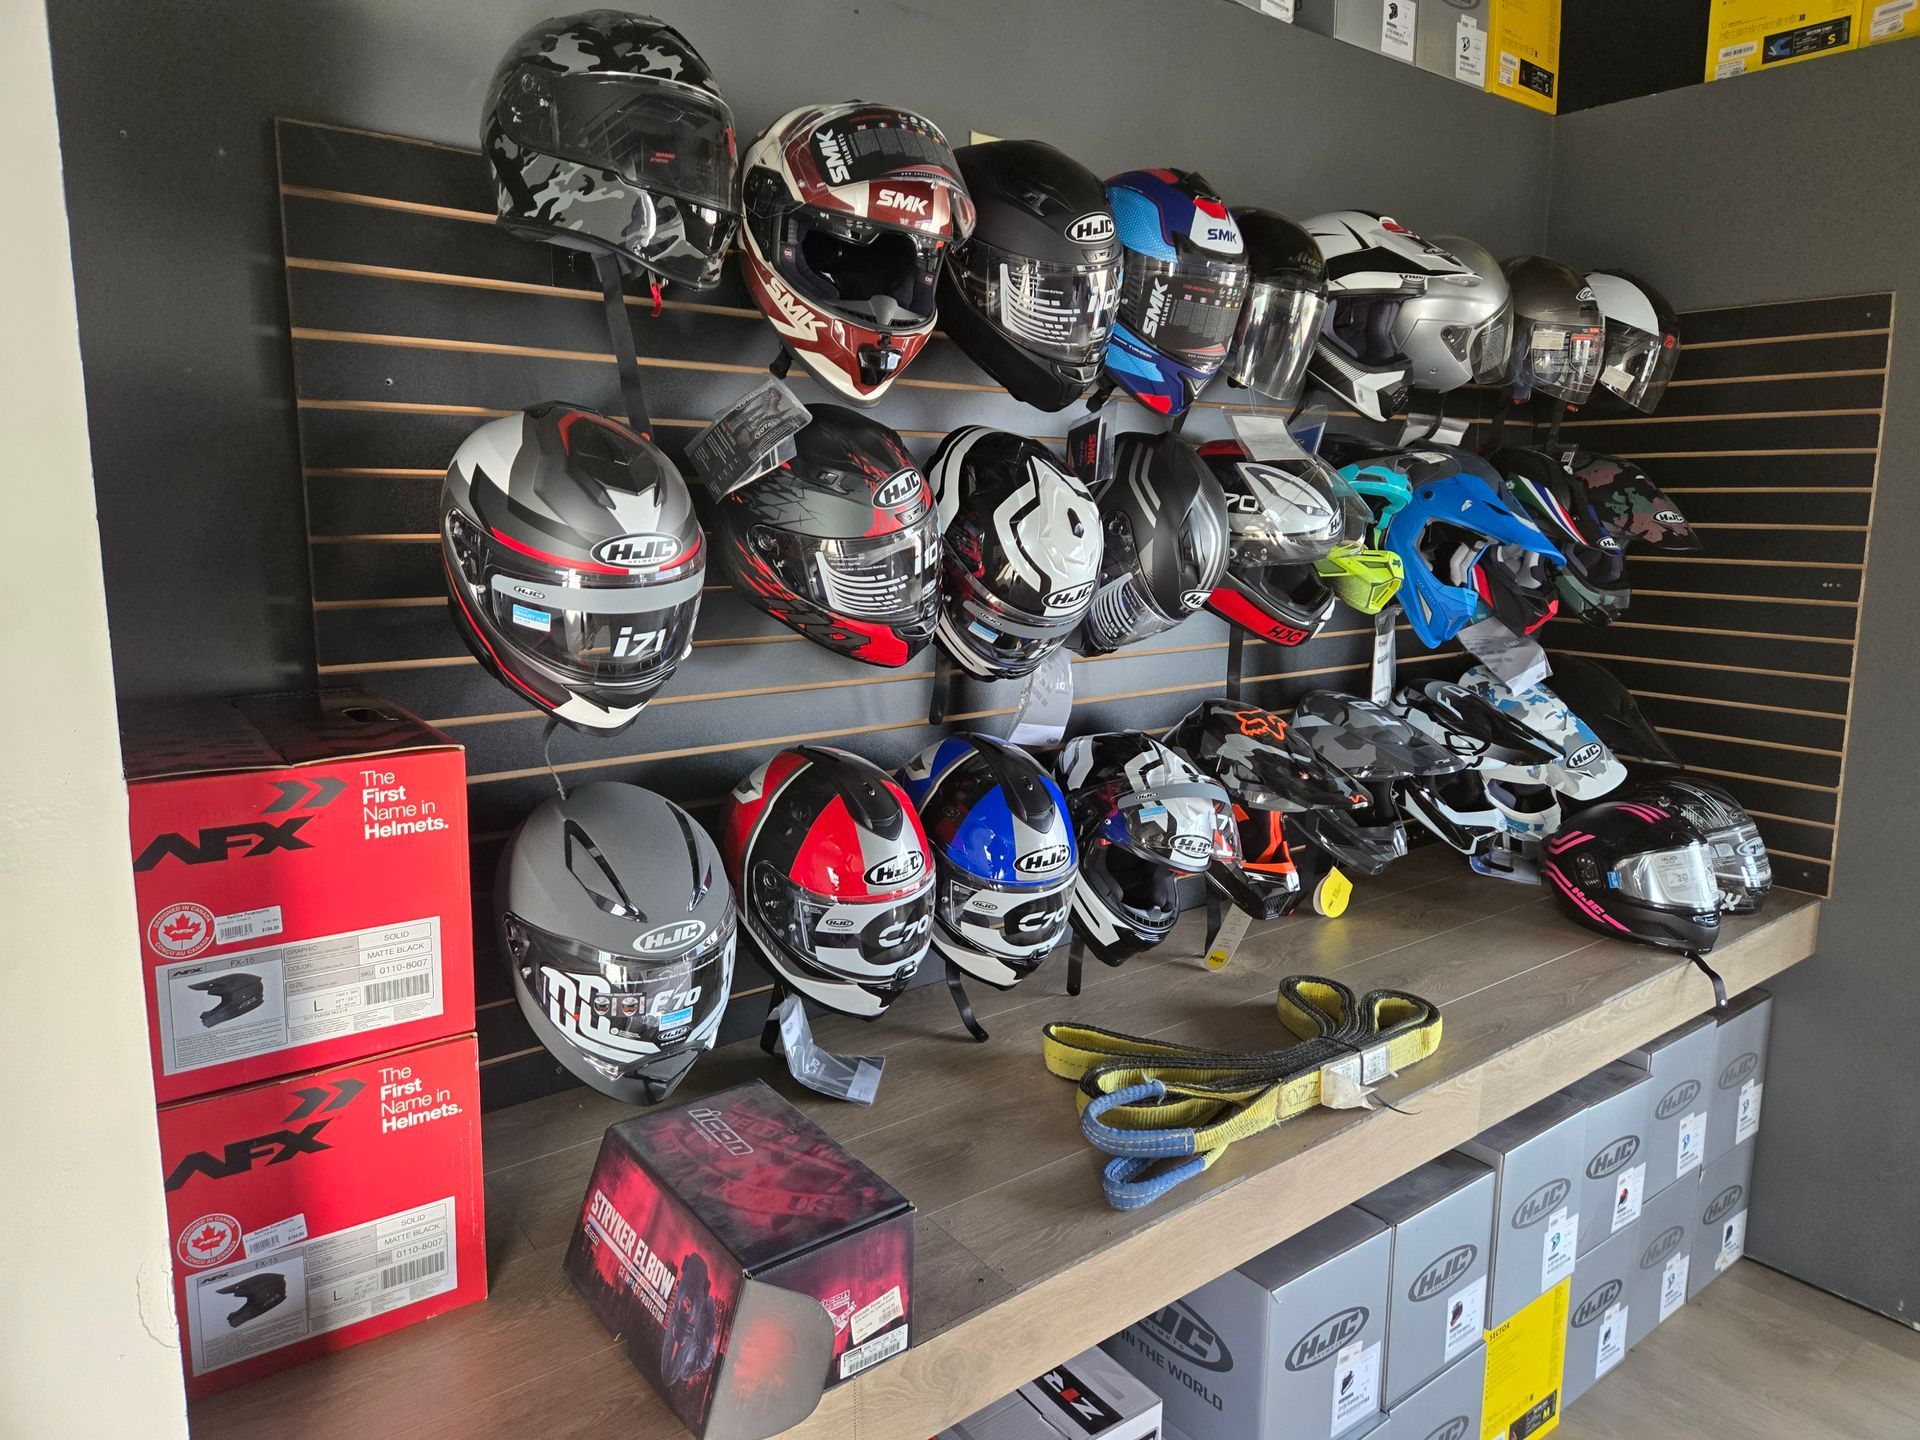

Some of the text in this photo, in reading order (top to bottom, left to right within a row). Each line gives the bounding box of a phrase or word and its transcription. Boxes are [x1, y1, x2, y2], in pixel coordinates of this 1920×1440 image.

[816, 128, 850, 183] SMK
[838, 133, 853, 165] HELMETS
[876, 188, 929, 215] SMK
[1077, 219, 1112, 239] HJC
[1207, 228, 1237, 244] SMK
[766, 277, 828, 341] SMK
[1143, 277, 1169, 338] SMK
[1160, 294, 1173, 327] HELMETS
[755, 419, 780, 438] TOTAL
[884, 472, 920, 505] HJC
[606, 540, 675, 562] HJC
[517, 587, 542, 599] HJC
[1052, 584, 1093, 605] HJC
[1184, 591, 1209, 607] HJ
[613, 627, 667, 657] i71
[1266, 623, 1308, 643] HJC
[1571, 744, 1600, 767] HJC
[360, 770, 395, 787] The
[363, 785, 406, 805] First
[363, 800, 436, 823] Name in
[365, 817, 449, 840] Helmets.
[134, 815, 315, 872] AFX
[1025, 848, 1066, 869] HJC
[1571, 885, 1607, 917] HJC
[153, 905, 180, 928] DESIGNED
[191, 906, 212, 923] CANADA
[1018, 906, 1067, 932] C70
[383, 930, 410, 942] SOLID
[644, 923, 699, 950] HJC
[878, 915, 929, 948] C70
[187, 936, 211, 955] CANADA
[367, 942, 425, 960] MATTE BLACK
[230, 956, 255, 968] FX-15
[379, 958, 428, 975] 0110-8007
[1209, 955, 1224, 964] Mips
[360, 970, 375, 978] SKU
[314, 1000, 324, 1012] L
[662, 1027, 689, 1039] HJC
[379, 1066, 412, 1086] The
[1722, 1056, 1754, 1087] HJC
[380, 1078, 423, 1101] First
[1661, 1083, 1696, 1116] HJC
[381, 1087, 451, 1118] Name in
[382, 1103, 463, 1134] Helmets.
[688, 1108, 754, 1156] icon
[165, 1118, 334, 1193] AFX
[1593, 1140, 1634, 1175] HJC
[1518, 1182, 1564, 1225] HJC
[1708, 1188, 1738, 1222] HJC
[214, 1215, 236, 1228] CANADA
[400, 1213, 426, 1227] SOLID
[384, 1223, 440, 1246] MATTE BLACK
[591, 1189, 637, 1258] STRYKER
[632, 1238, 676, 1300] ELBOW
[217, 1240, 237, 1261] CANADA
[396, 1238, 443, 1259] 0110-8007
[1644, 1230, 1680, 1269] HJC
[255, 1256, 278, 1269] FX-15
[1418, 1248, 1470, 1298] HJC
[333, 1290, 344, 1302] L
[1578, 1284, 1616, 1323] HJC
[1296, 1311, 1360, 1367] HJC
[1489, 1322, 1511, 1341] SECTOR
[1137, 1338, 1165, 1369] THE
[1167, 1360, 1223, 1412] WORLD
